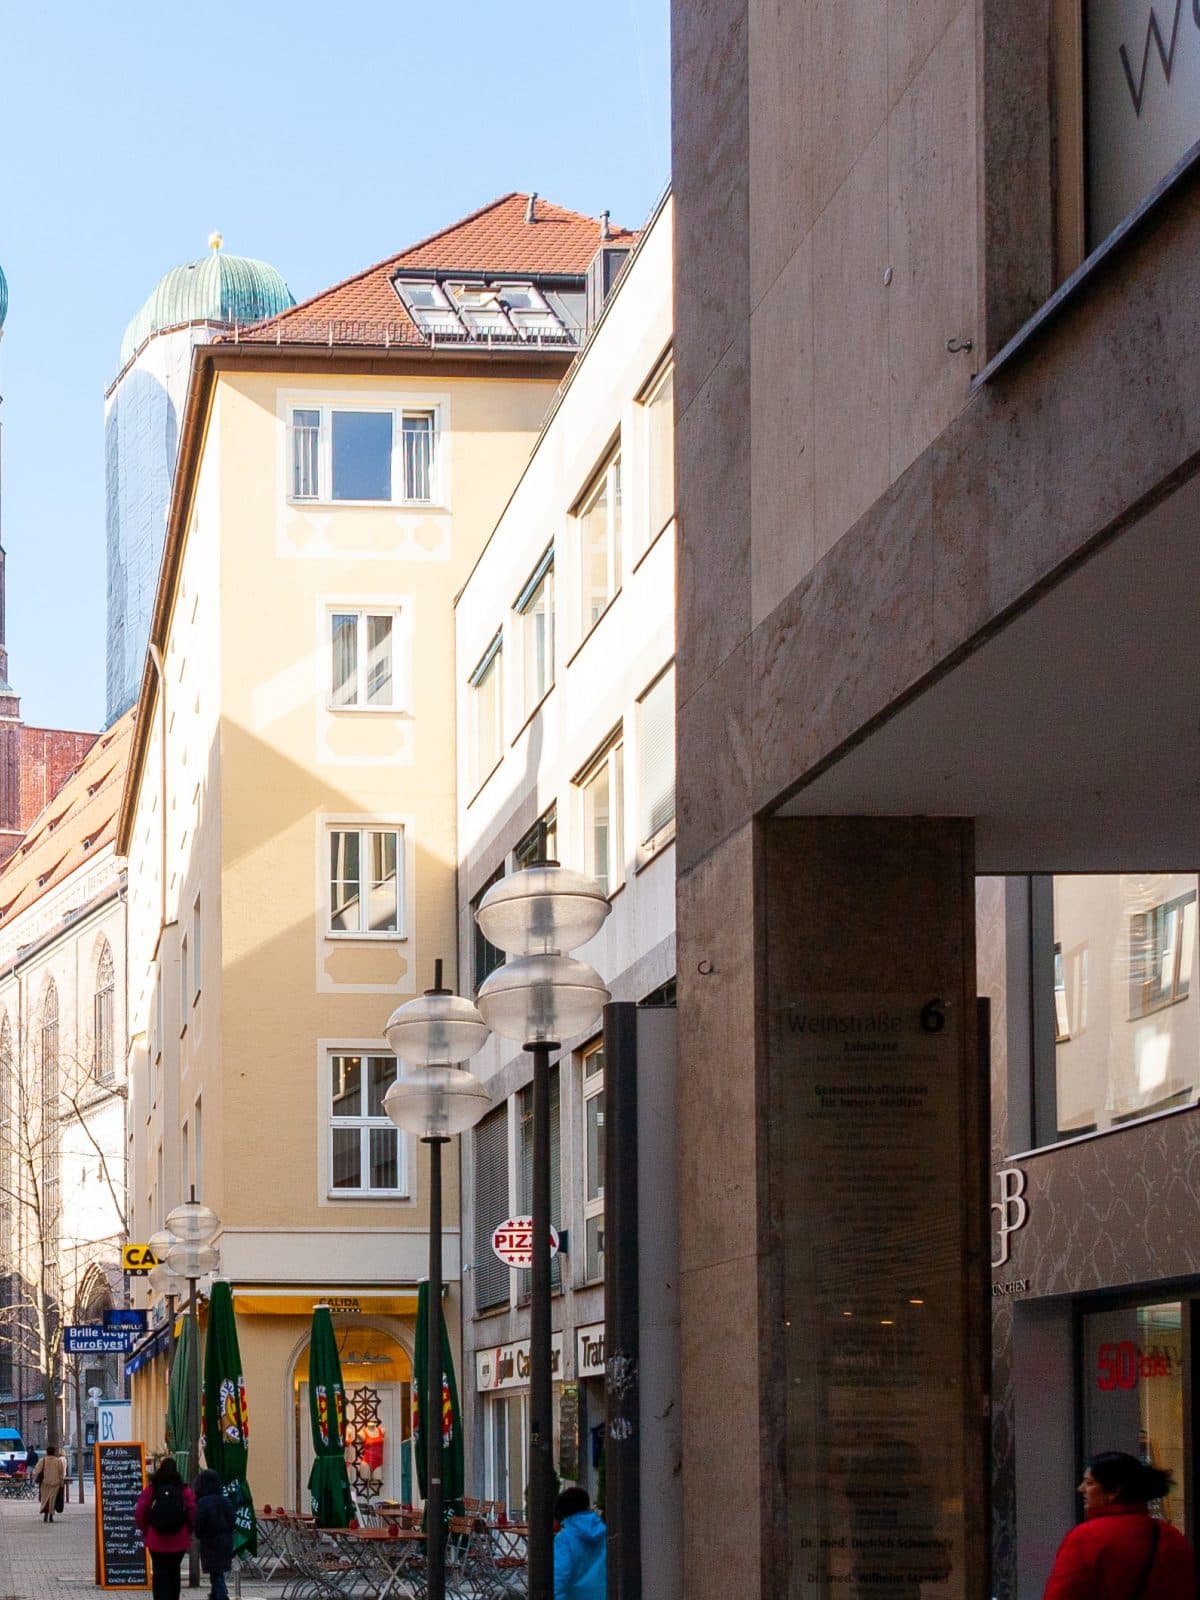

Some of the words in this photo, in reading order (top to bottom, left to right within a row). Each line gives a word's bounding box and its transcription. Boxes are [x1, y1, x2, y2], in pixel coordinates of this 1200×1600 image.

[1119, 0, 1200, 119] W
[788, 1012, 902, 1034] Weinstraße
[919, 997, 945, 1034] 6
[494, 1234, 557, 1249] PIZ
[992, 1279, 1026, 1296] ÜNCHEN
[318, 1298, 360, 1307] CALIDA
[70, 1328, 99, 1338] Brille
[70, 1339, 128, 1350] EuroEyes!
[516, 1348, 531, 1378] Ca
